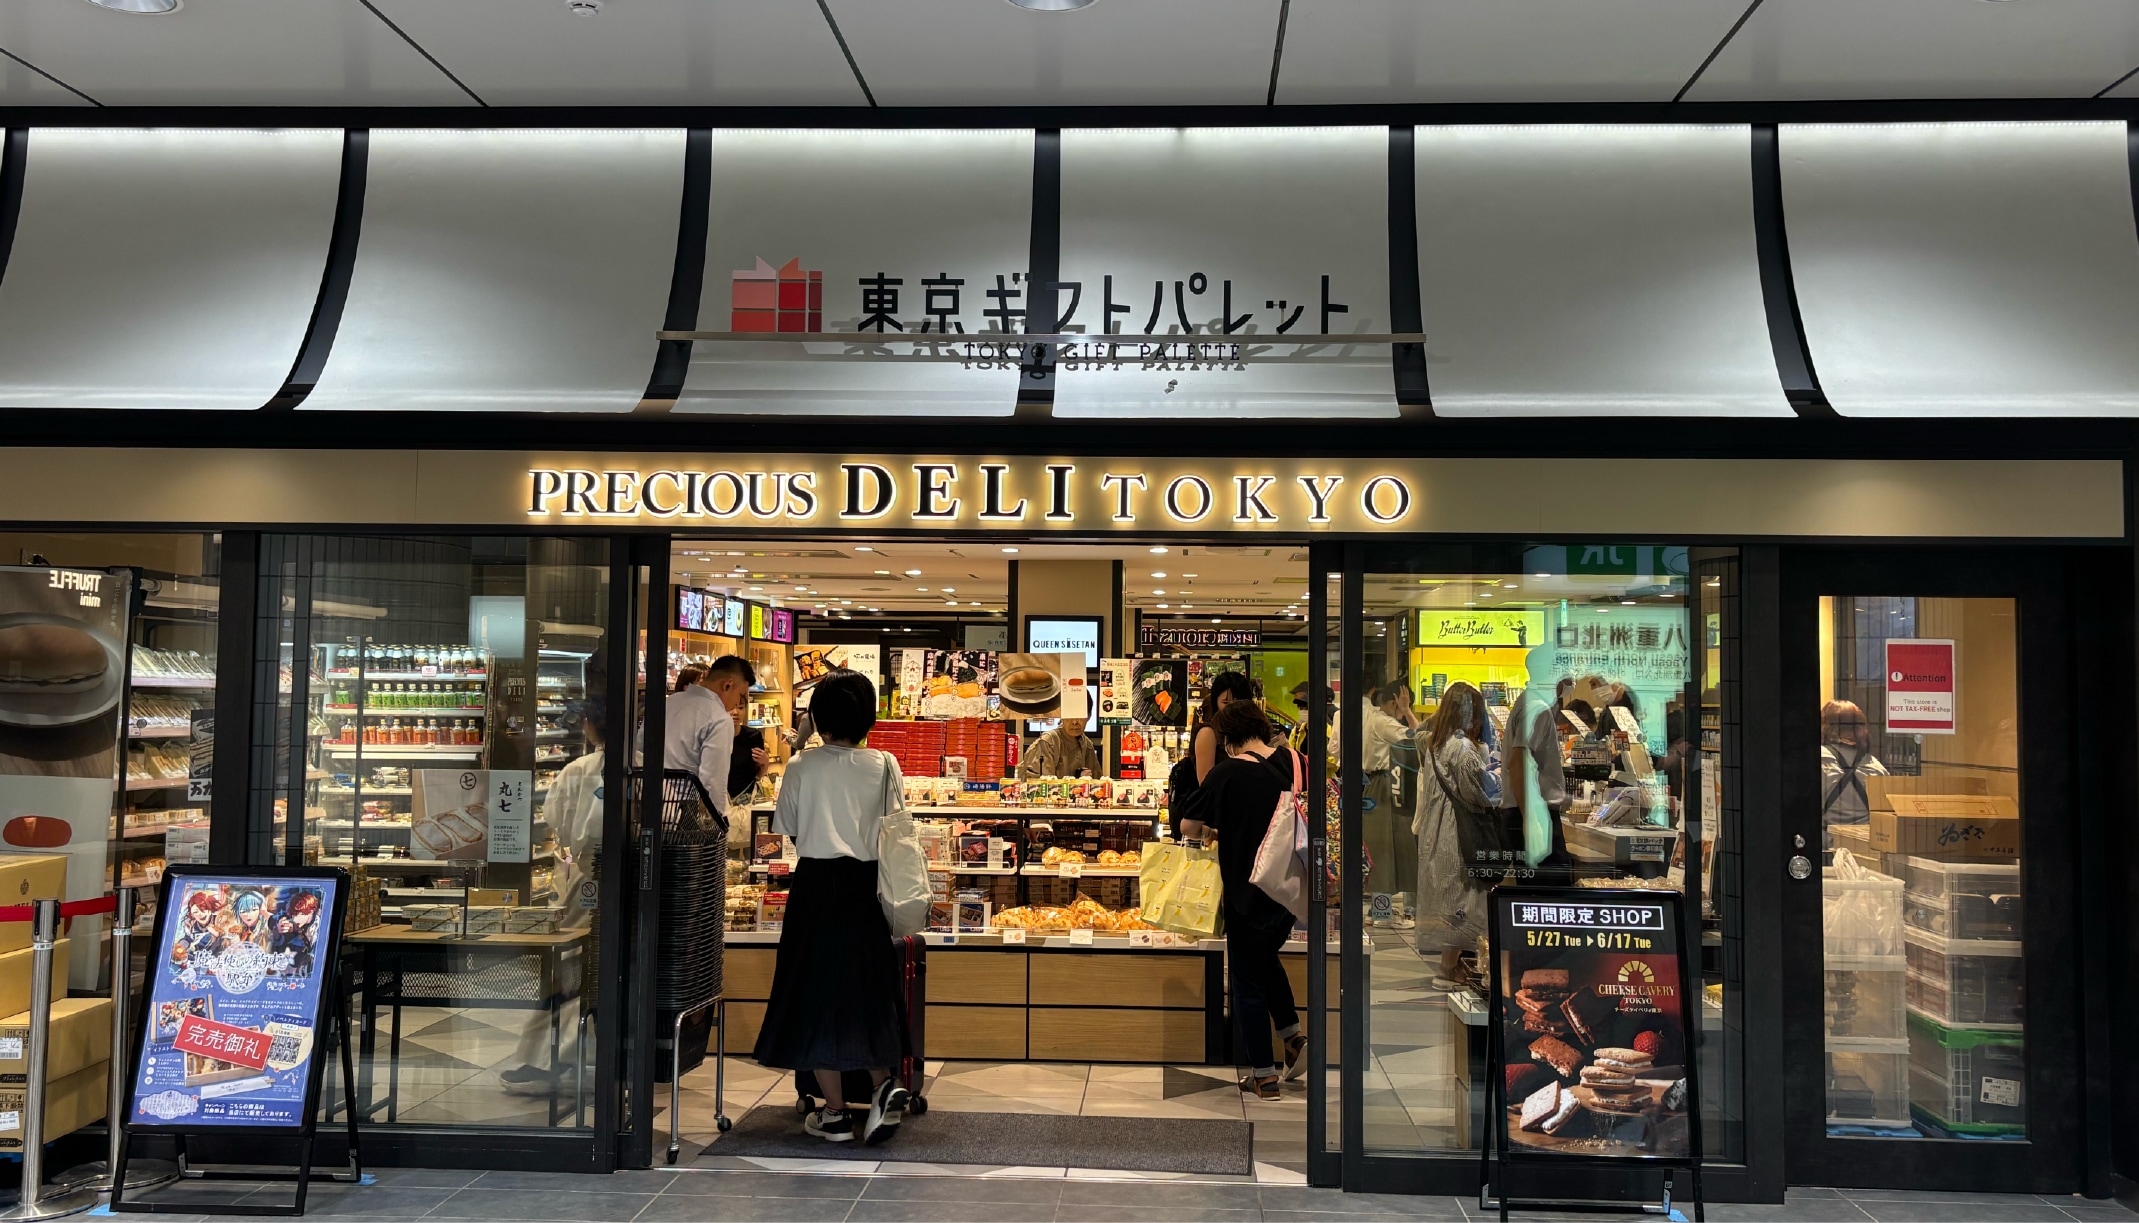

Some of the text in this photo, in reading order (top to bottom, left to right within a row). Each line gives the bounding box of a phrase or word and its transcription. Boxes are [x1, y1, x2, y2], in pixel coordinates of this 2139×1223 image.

[858, 272, 1348, 334] 東京ギフトパレット
[964, 343, 1240, 360] TOKYO GIFT PALETTE
[528, 463, 1411, 523] PRECIOUS DELI TOKYO
[1903, 674, 1946, 683] Attention
[1476, 850, 1526, 861] 営業時間
[1522, 906, 1653, 924] 期間限定 SHOP
[1527, 930, 1652, 949] 5/27 Tue 6/17 Tue
[1598, 984, 1675, 996] CHEESE CAVERY
[1624, 997, 1653, 1005] TOKYO
[184, 1023, 262, 1061] 完売御礼
